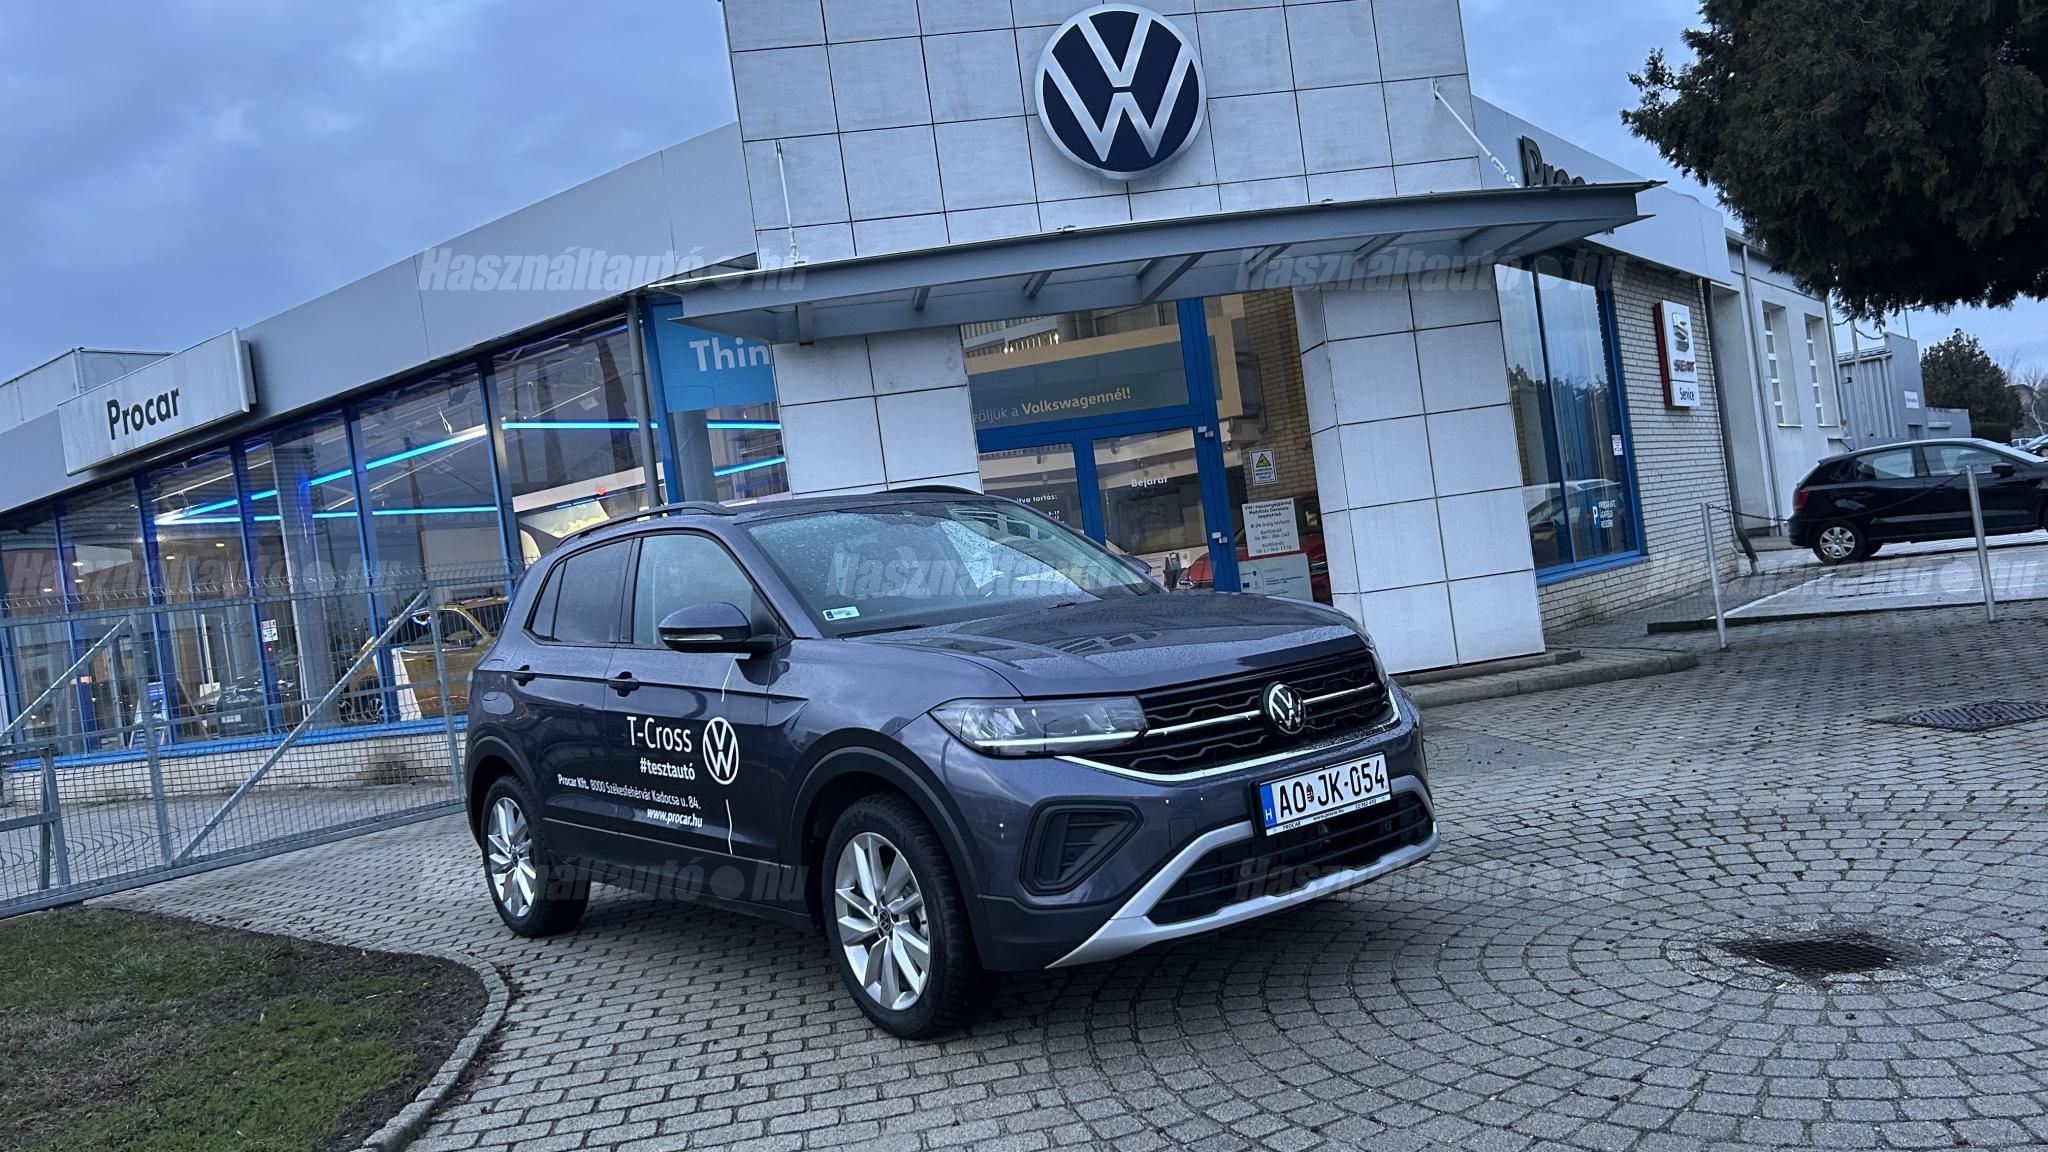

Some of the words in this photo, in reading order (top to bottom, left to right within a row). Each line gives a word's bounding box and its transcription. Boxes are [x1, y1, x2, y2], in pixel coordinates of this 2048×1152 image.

[688, 336, 770, 372] Thin
[1011, 407, 1020, 417] a
[1021, 386, 1131, 415] Volkswagennél!
[1679, 387, 1696, 401] Service
[107, 387, 180, 440] Procar
[1592, 506, 1598, 525] P
[627, 715, 693, 753] T-Cross
[640, 757, 696, 781] #tesztautó
[557, 773, 577, 787] Procar
[577, 777, 590, 790] Kft.
[590, 779, 606, 793] 8000
[606, 781, 651, 800] Székesfehérvár
[651, 789, 680, 806] Kadocsa
[680, 797, 688, 807] u.
[688, 795, 702, 810] 84.
[646, 807, 703, 828] www.procar.hu
[1265, 807, 1273, 821] H
